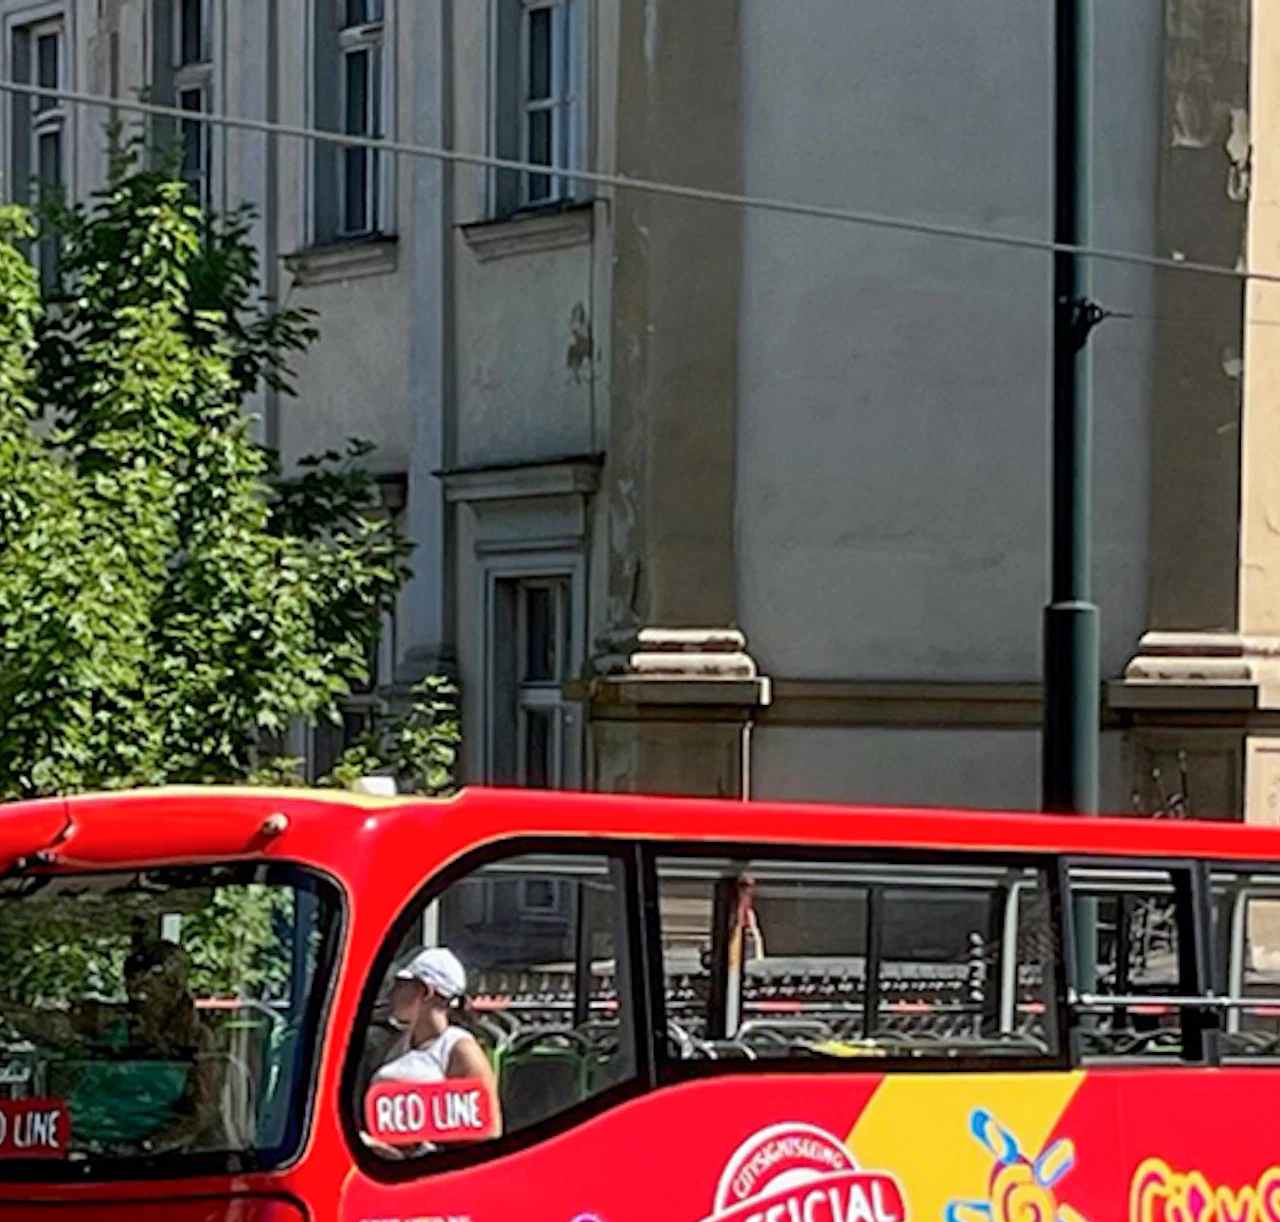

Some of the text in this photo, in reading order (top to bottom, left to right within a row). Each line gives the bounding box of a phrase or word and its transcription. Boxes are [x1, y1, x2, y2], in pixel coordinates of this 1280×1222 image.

[14, 1110, 60, 1148] LINE
[376, 1091, 484, 1132] RED LINE
